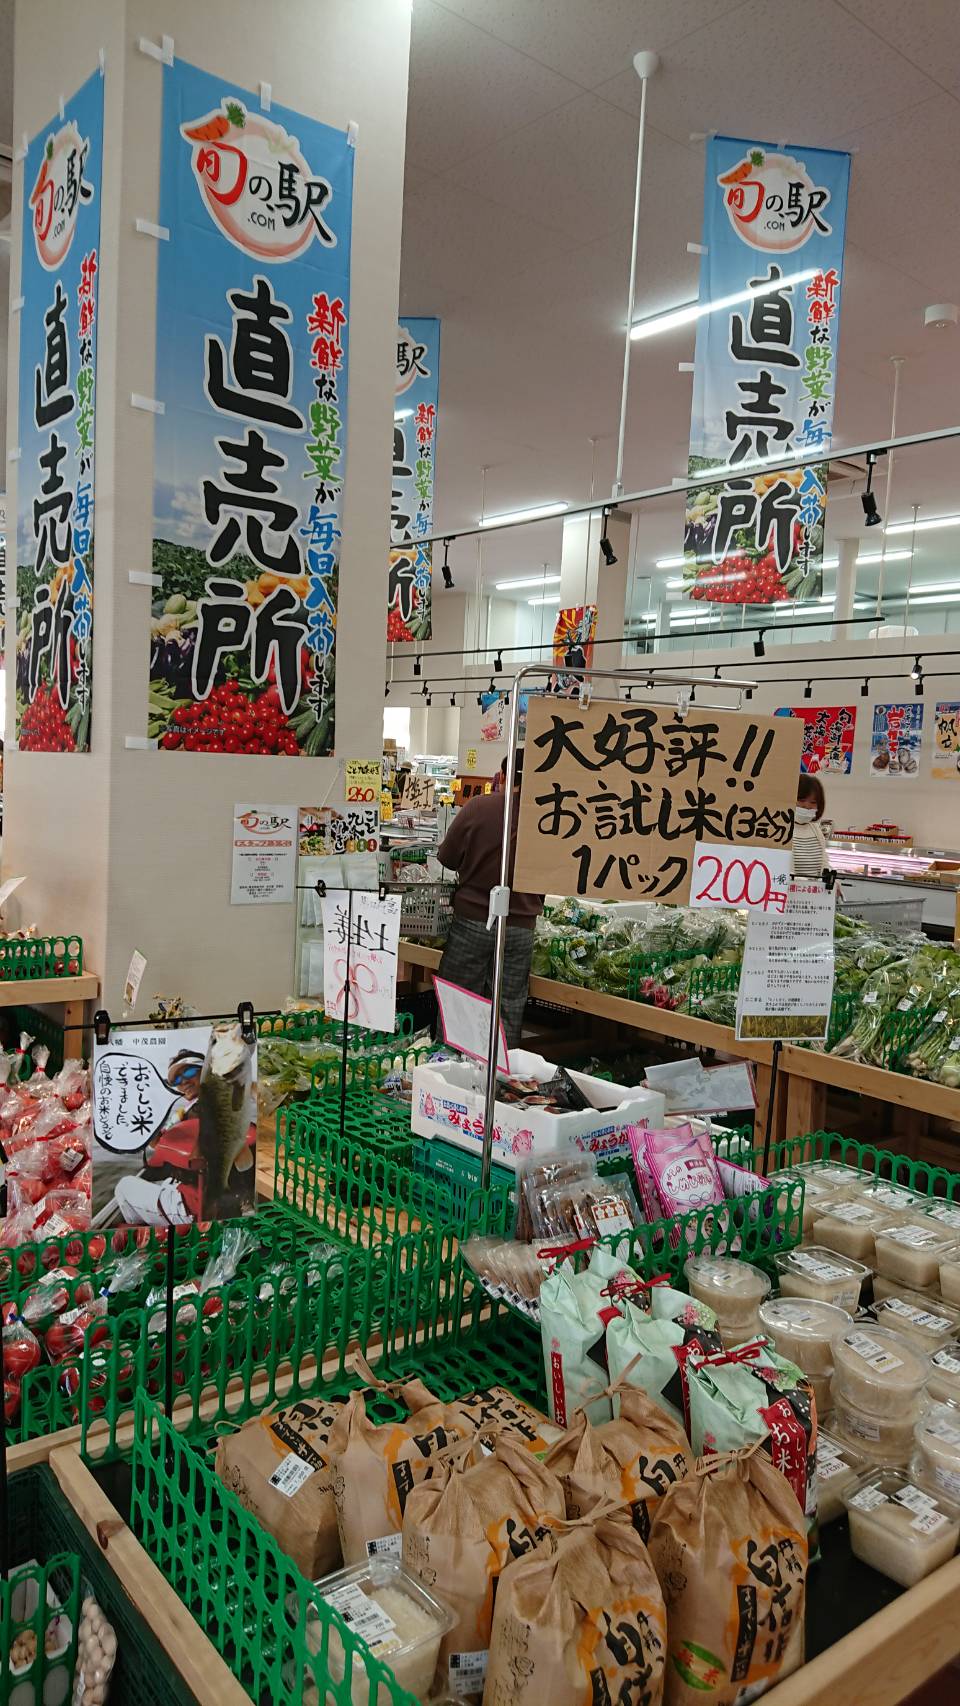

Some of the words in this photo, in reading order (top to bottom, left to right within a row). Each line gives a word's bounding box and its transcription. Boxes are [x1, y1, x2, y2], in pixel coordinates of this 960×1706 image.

[33, 143, 92, 240] 旬の駅
[196, 142, 336, 243] 旬の駅
[727, 181, 829, 232] 旬の駅
[29, 285, 75, 708] 直売所
[72, 251, 97, 713] 新鮮な野菜が毎日入荷します
[193, 280, 308, 712] 直売所
[301, 293, 347, 721] 新鮮な野菜が毎日入荷します
[714, 265, 801, 572] 直売所
[797, 270, 839, 577] 新鮮な野菜が毎入荷します
